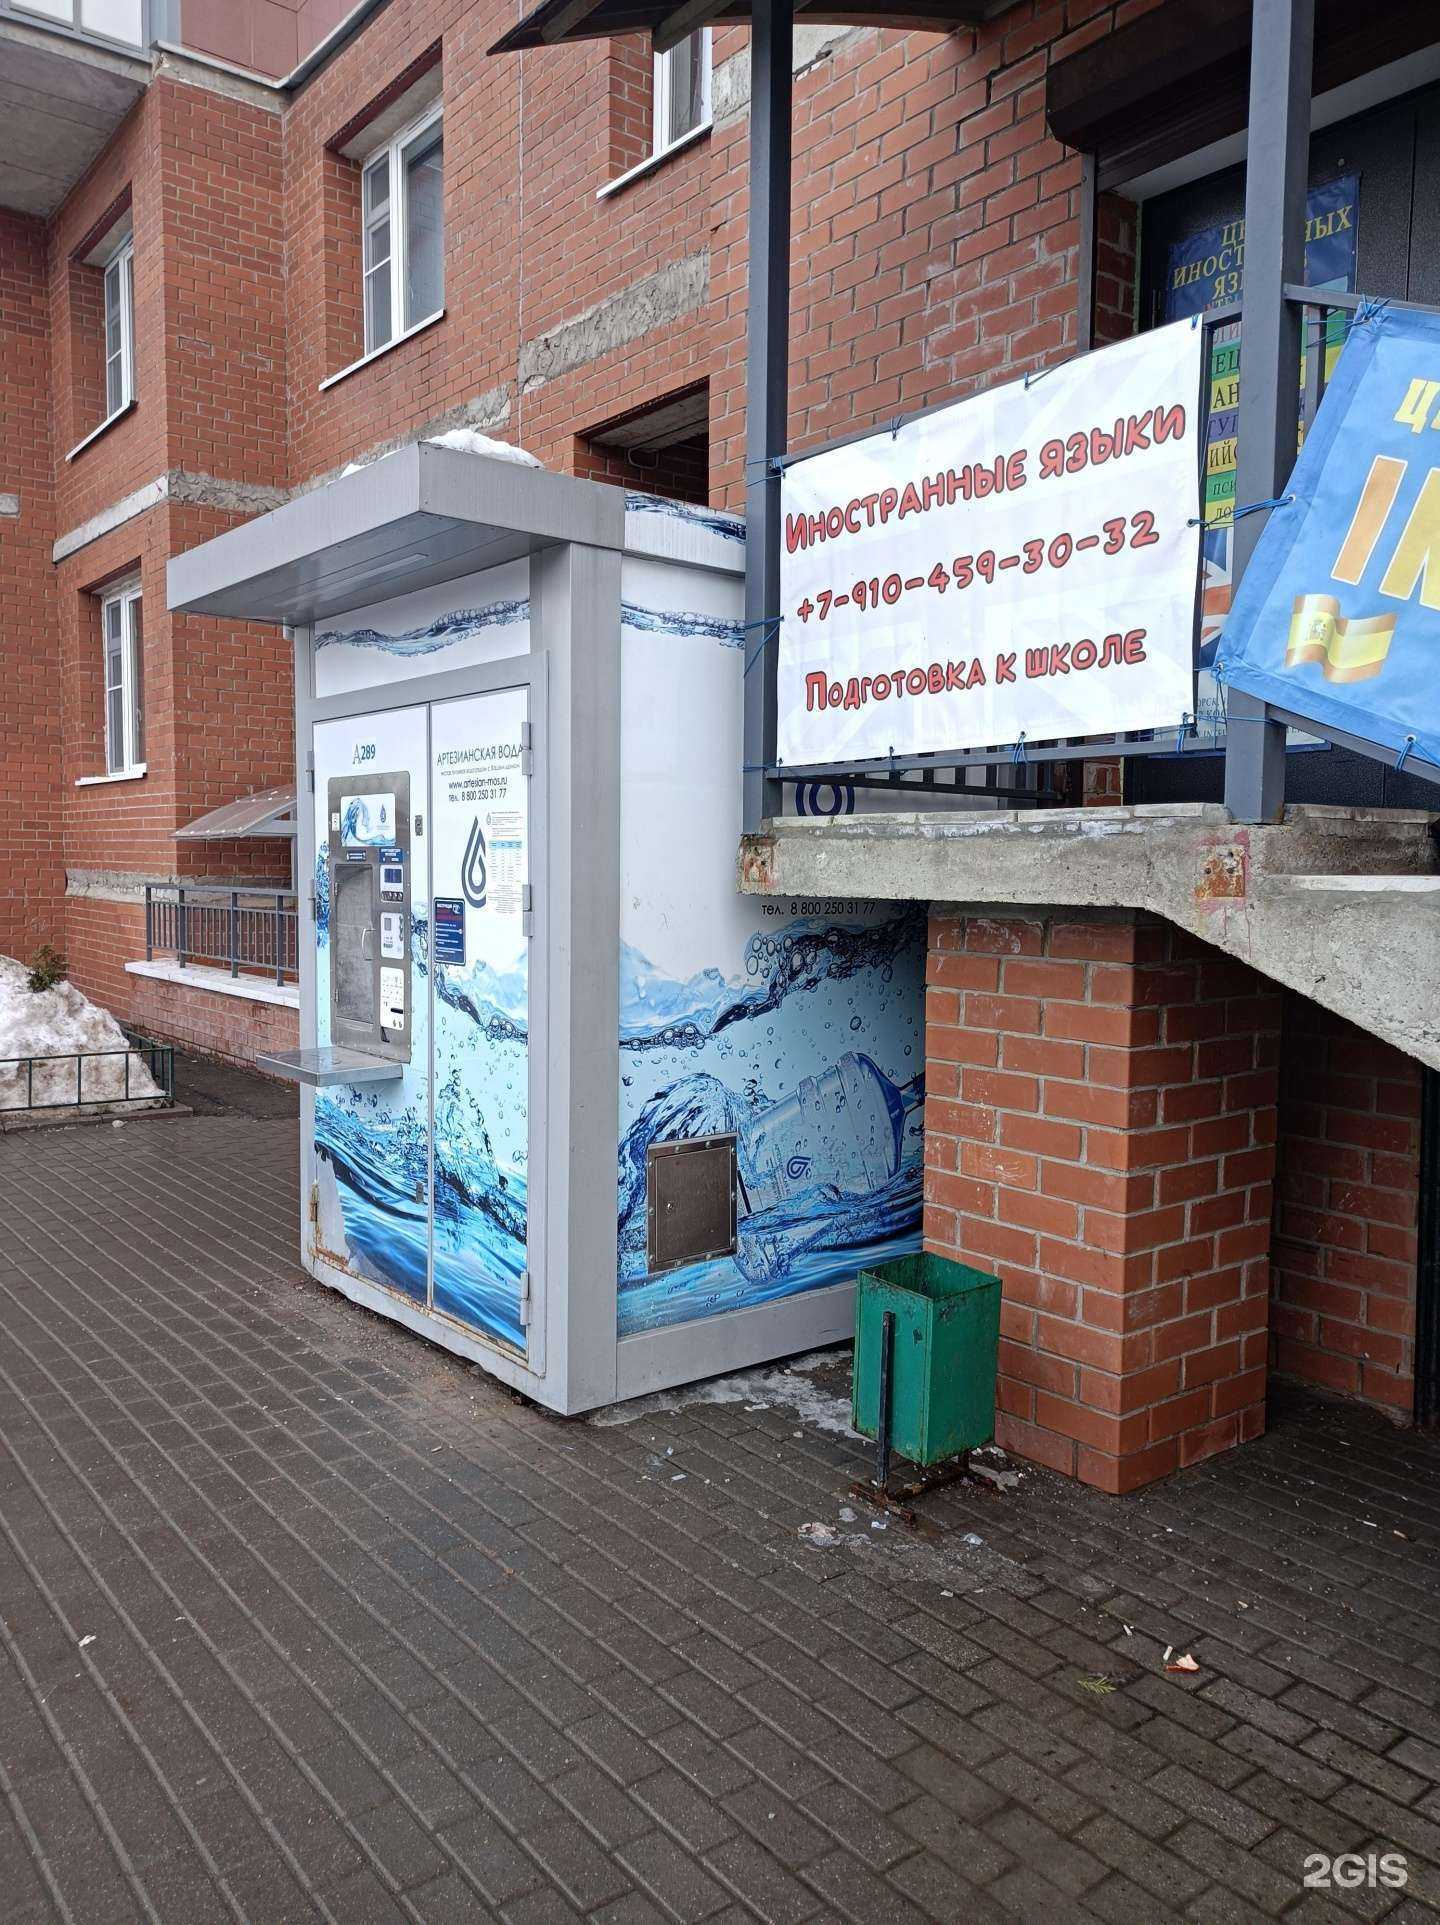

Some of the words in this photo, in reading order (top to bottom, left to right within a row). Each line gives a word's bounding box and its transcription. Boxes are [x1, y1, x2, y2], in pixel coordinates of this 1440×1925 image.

[797, 511, 1160, 624] +7-910-459-30-32
[437, 746, 496, 767] АРТЕЗИАНСКАЯ
[466, 790, 477, 801] 800
[478, 789, 488, 800] 250
[761, 905, 784, 915] тел.
[790, 902, 798, 915] 8
[801, 902, 821, 915] 800
[824, 902, 844, 914] 250
[847, 902, 859, 914] 31
[863, 902, 876, 914] 77
